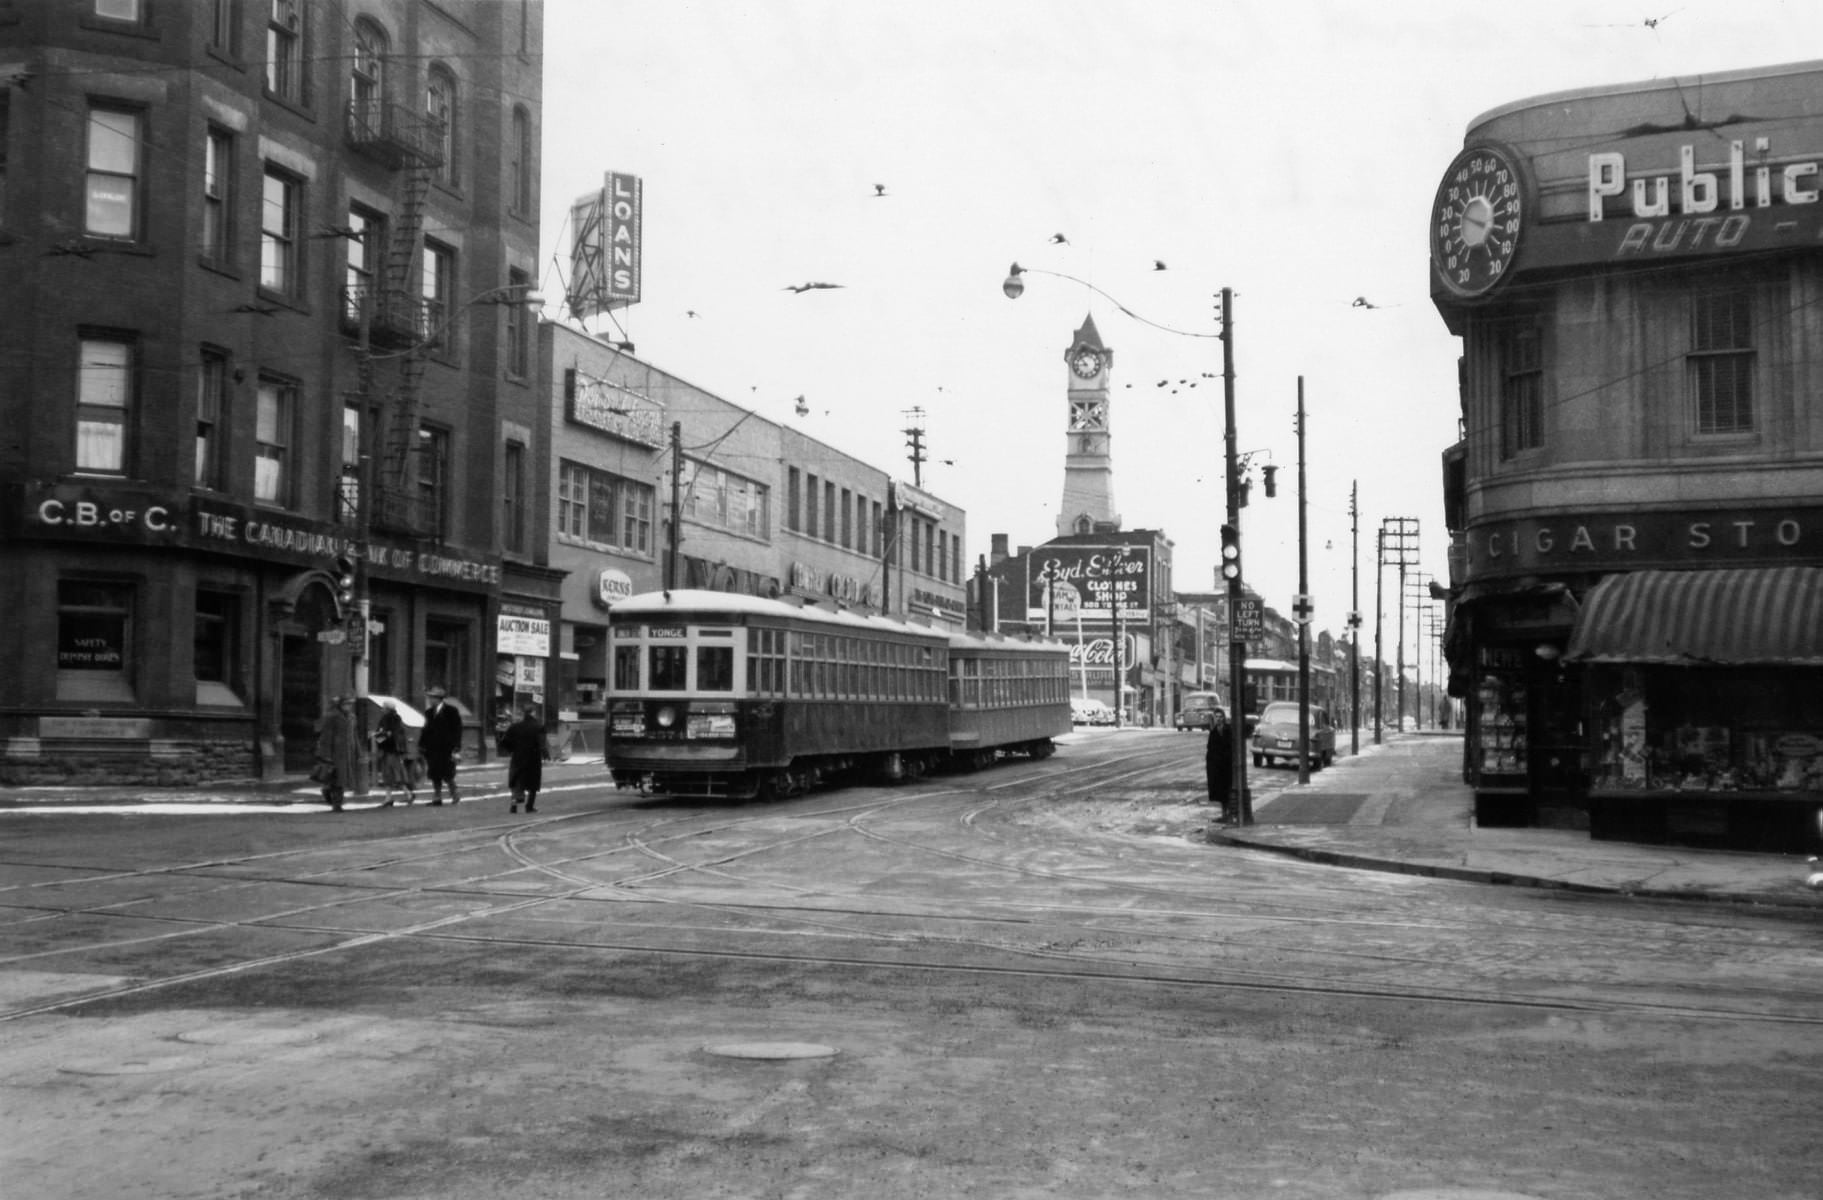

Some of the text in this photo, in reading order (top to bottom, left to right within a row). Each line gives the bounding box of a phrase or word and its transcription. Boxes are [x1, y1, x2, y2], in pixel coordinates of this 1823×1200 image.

[1471, 158, 1482, 174] 50
[1485, 158, 1496, 173] 60
[1456, 168, 1468, 181] 40
[1496, 169, 1508, 184] 70
[1589, 137, 1819, 222] Public
[1448, 187, 1459, 202] 30
[1504, 182, 1516, 198] 80
[1442, 206, 1453, 221] 20
[1506, 200, 1520, 215] 90
[614, 178, 632, 289] LOANS
[1440, 223, 1450, 238] 10
[1618, 215, 1751, 256] AUTO
[1445, 240, 1452, 253] 0
[1502, 240, 1512, 255] 10
[1448, 255, 1457, 270] 10
[1489, 259, 1501, 275] 20
[1458, 268, 1470, 283] 20
[39, 499, 106, 527] C.B.
[144, 506, 177, 531] C.
[1488, 519, 1801, 558] CIGAR STO
[199, 512, 237, 540] THE
[245, 521, 338, 557] CANADIAN
[418, 553, 498, 584] COMMERCE
[1241, 601, 1255, 609] NO
[1236, 610, 1260, 618] LEFT
[500, 618, 548, 635] AUCTION SALE
[1237, 619, 1260, 627] TURN
[652, 628, 684, 638] YONGE
